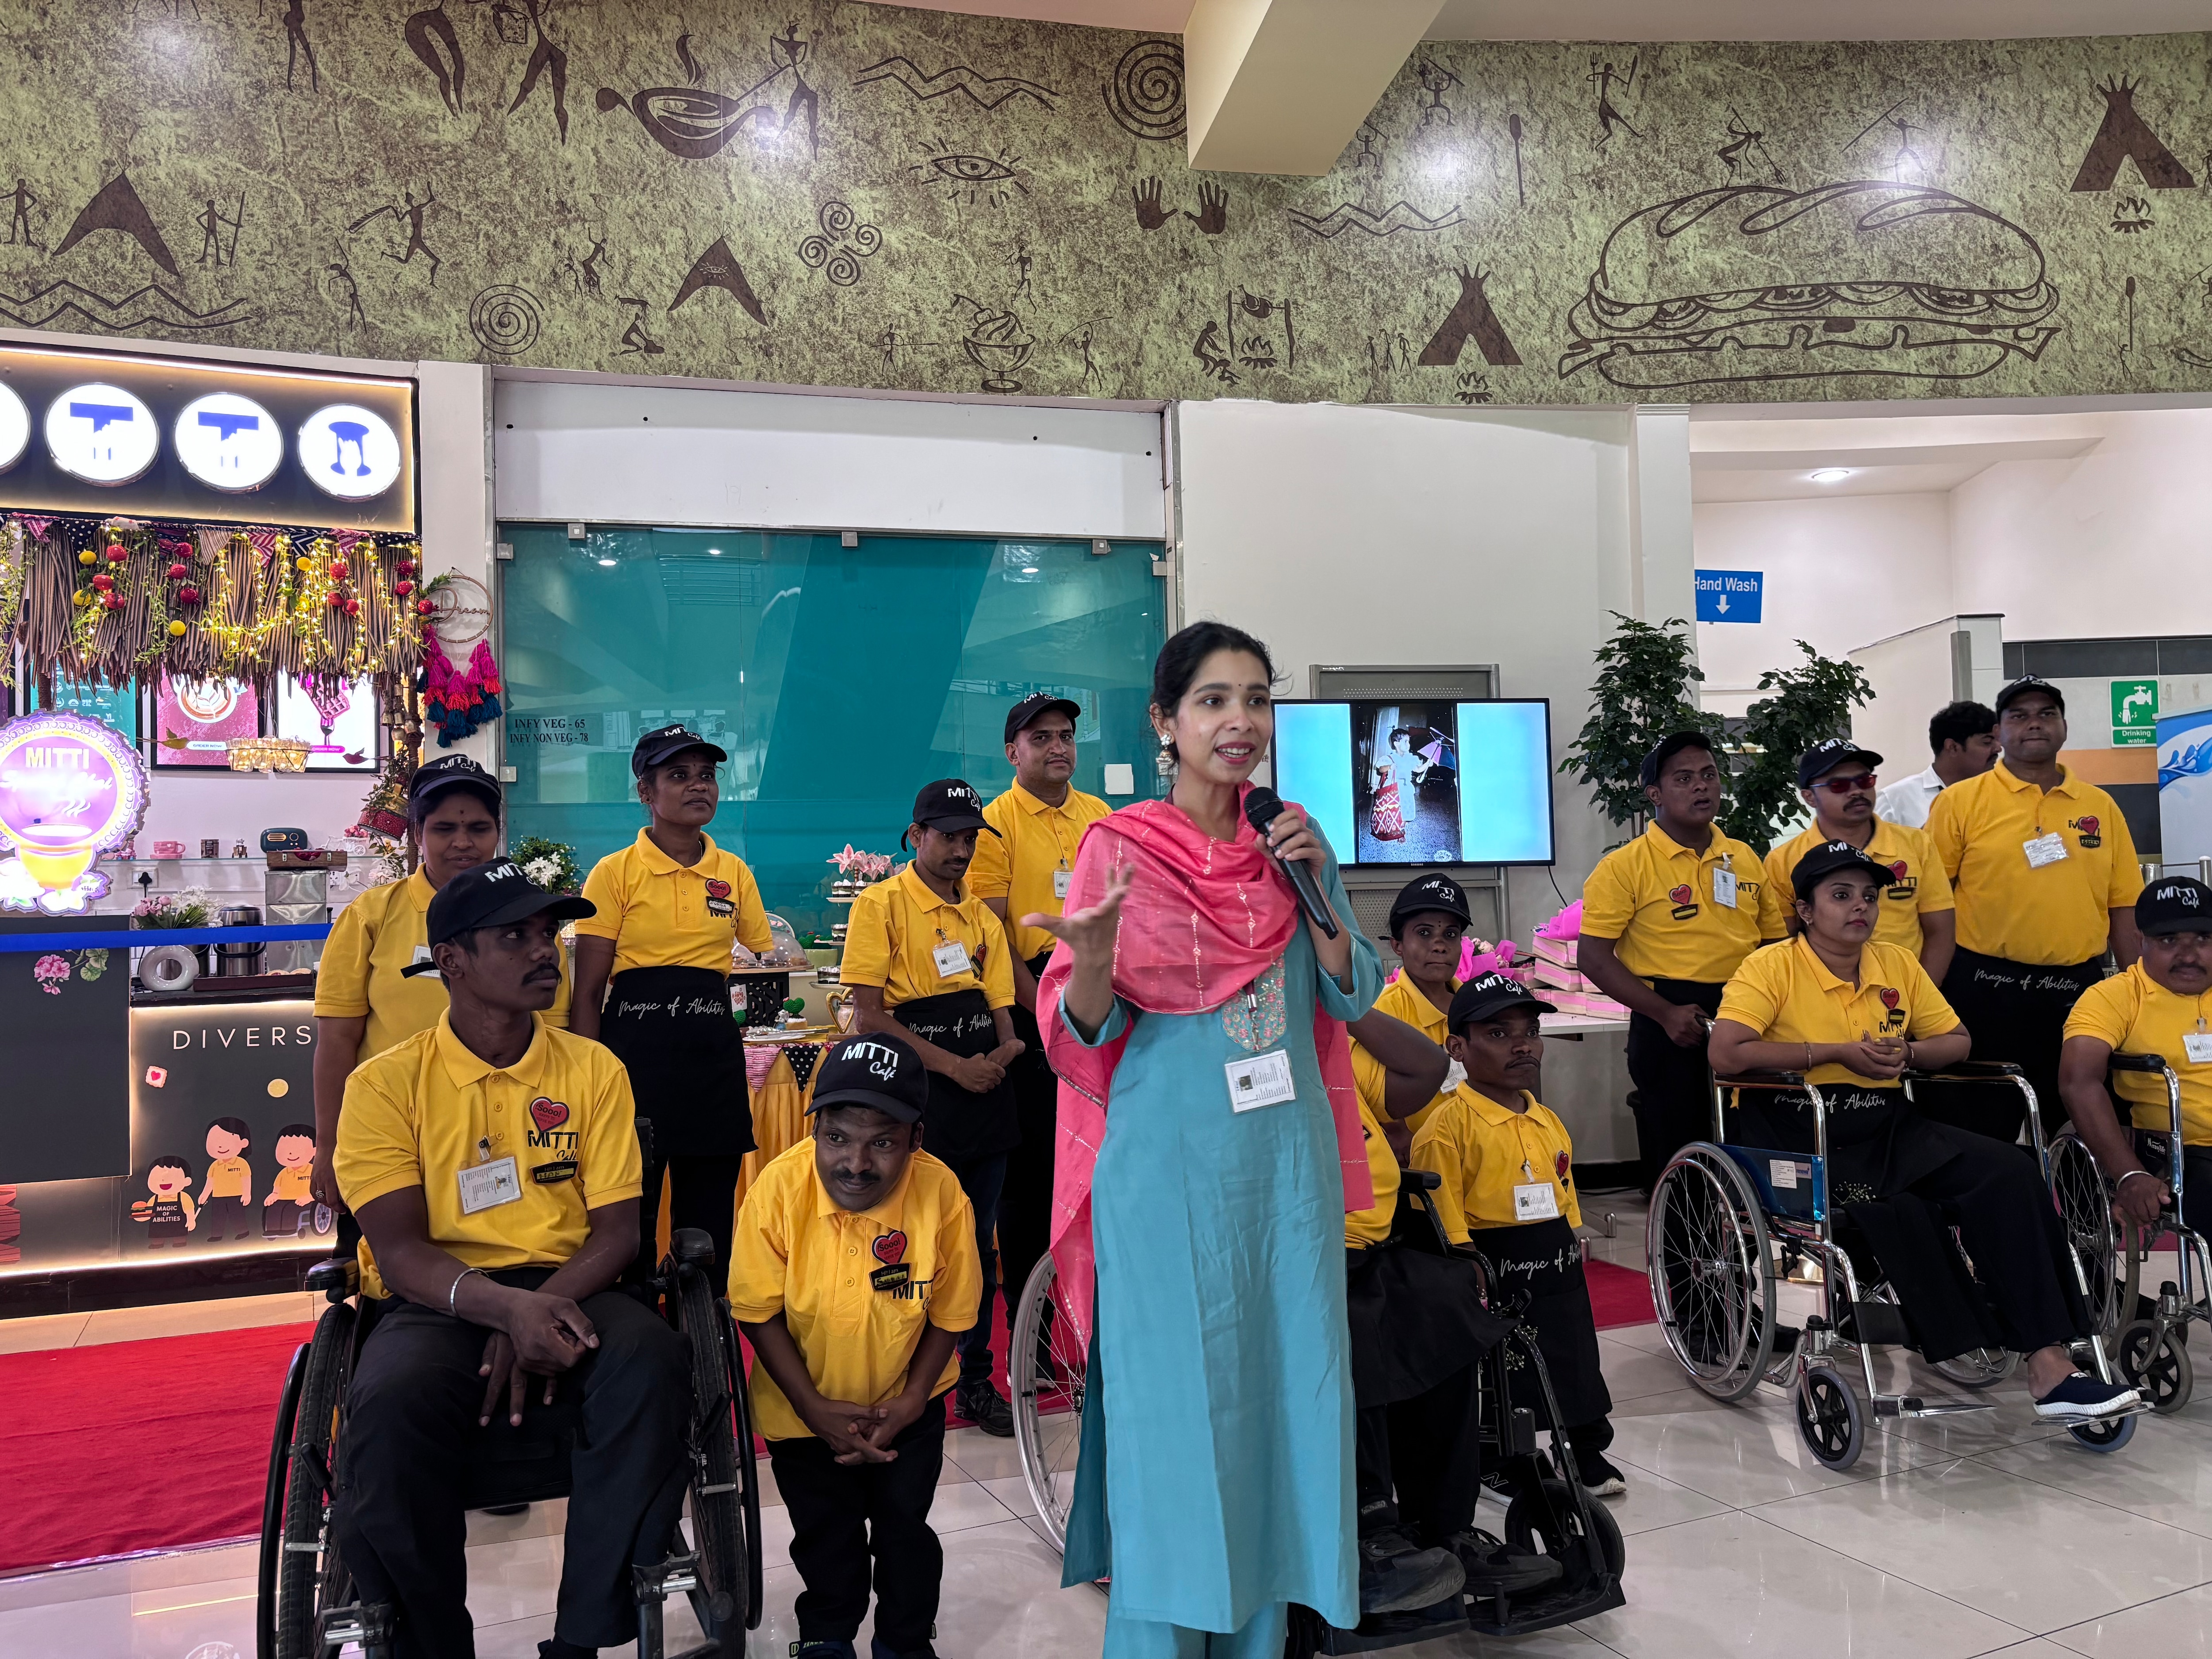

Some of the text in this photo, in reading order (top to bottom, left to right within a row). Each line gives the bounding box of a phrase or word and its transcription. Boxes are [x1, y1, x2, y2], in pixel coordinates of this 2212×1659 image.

[1694, 576, 1757, 592] Hand Wash
[515, 719, 540, 728] INFY
[542, 719, 566, 728] VEG
[575, 719, 585, 728] 65
[510, 733, 530, 743] INFY
[534, 733, 552, 743] NON
[554, 733, 572, 742] VEG
[580, 733, 588, 742] 78
[25, 746, 89, 769] MITTI
[484, 863, 523, 882] MIT
[2157, 885, 2198, 900] MITTI
[1974, 968, 2079, 991] Magic of Abilities
[618, 1000, 661, 1019] Magic
[667, 996, 680, 1017] of
[173, 1025, 312, 1050] DIVERS
[909, 1022, 947, 1041] Magic
[953, 1017, 964, 1037] of
[841, 1041, 899, 1068] MITTI
[869, 1061, 896, 1081] Café
[1825, 1093, 1837, 1114] of
[528, 1130, 579, 1149] MITTI
[1500, 1258, 1548, 1280] Magic
[1554, 1248, 1563, 1272] of
